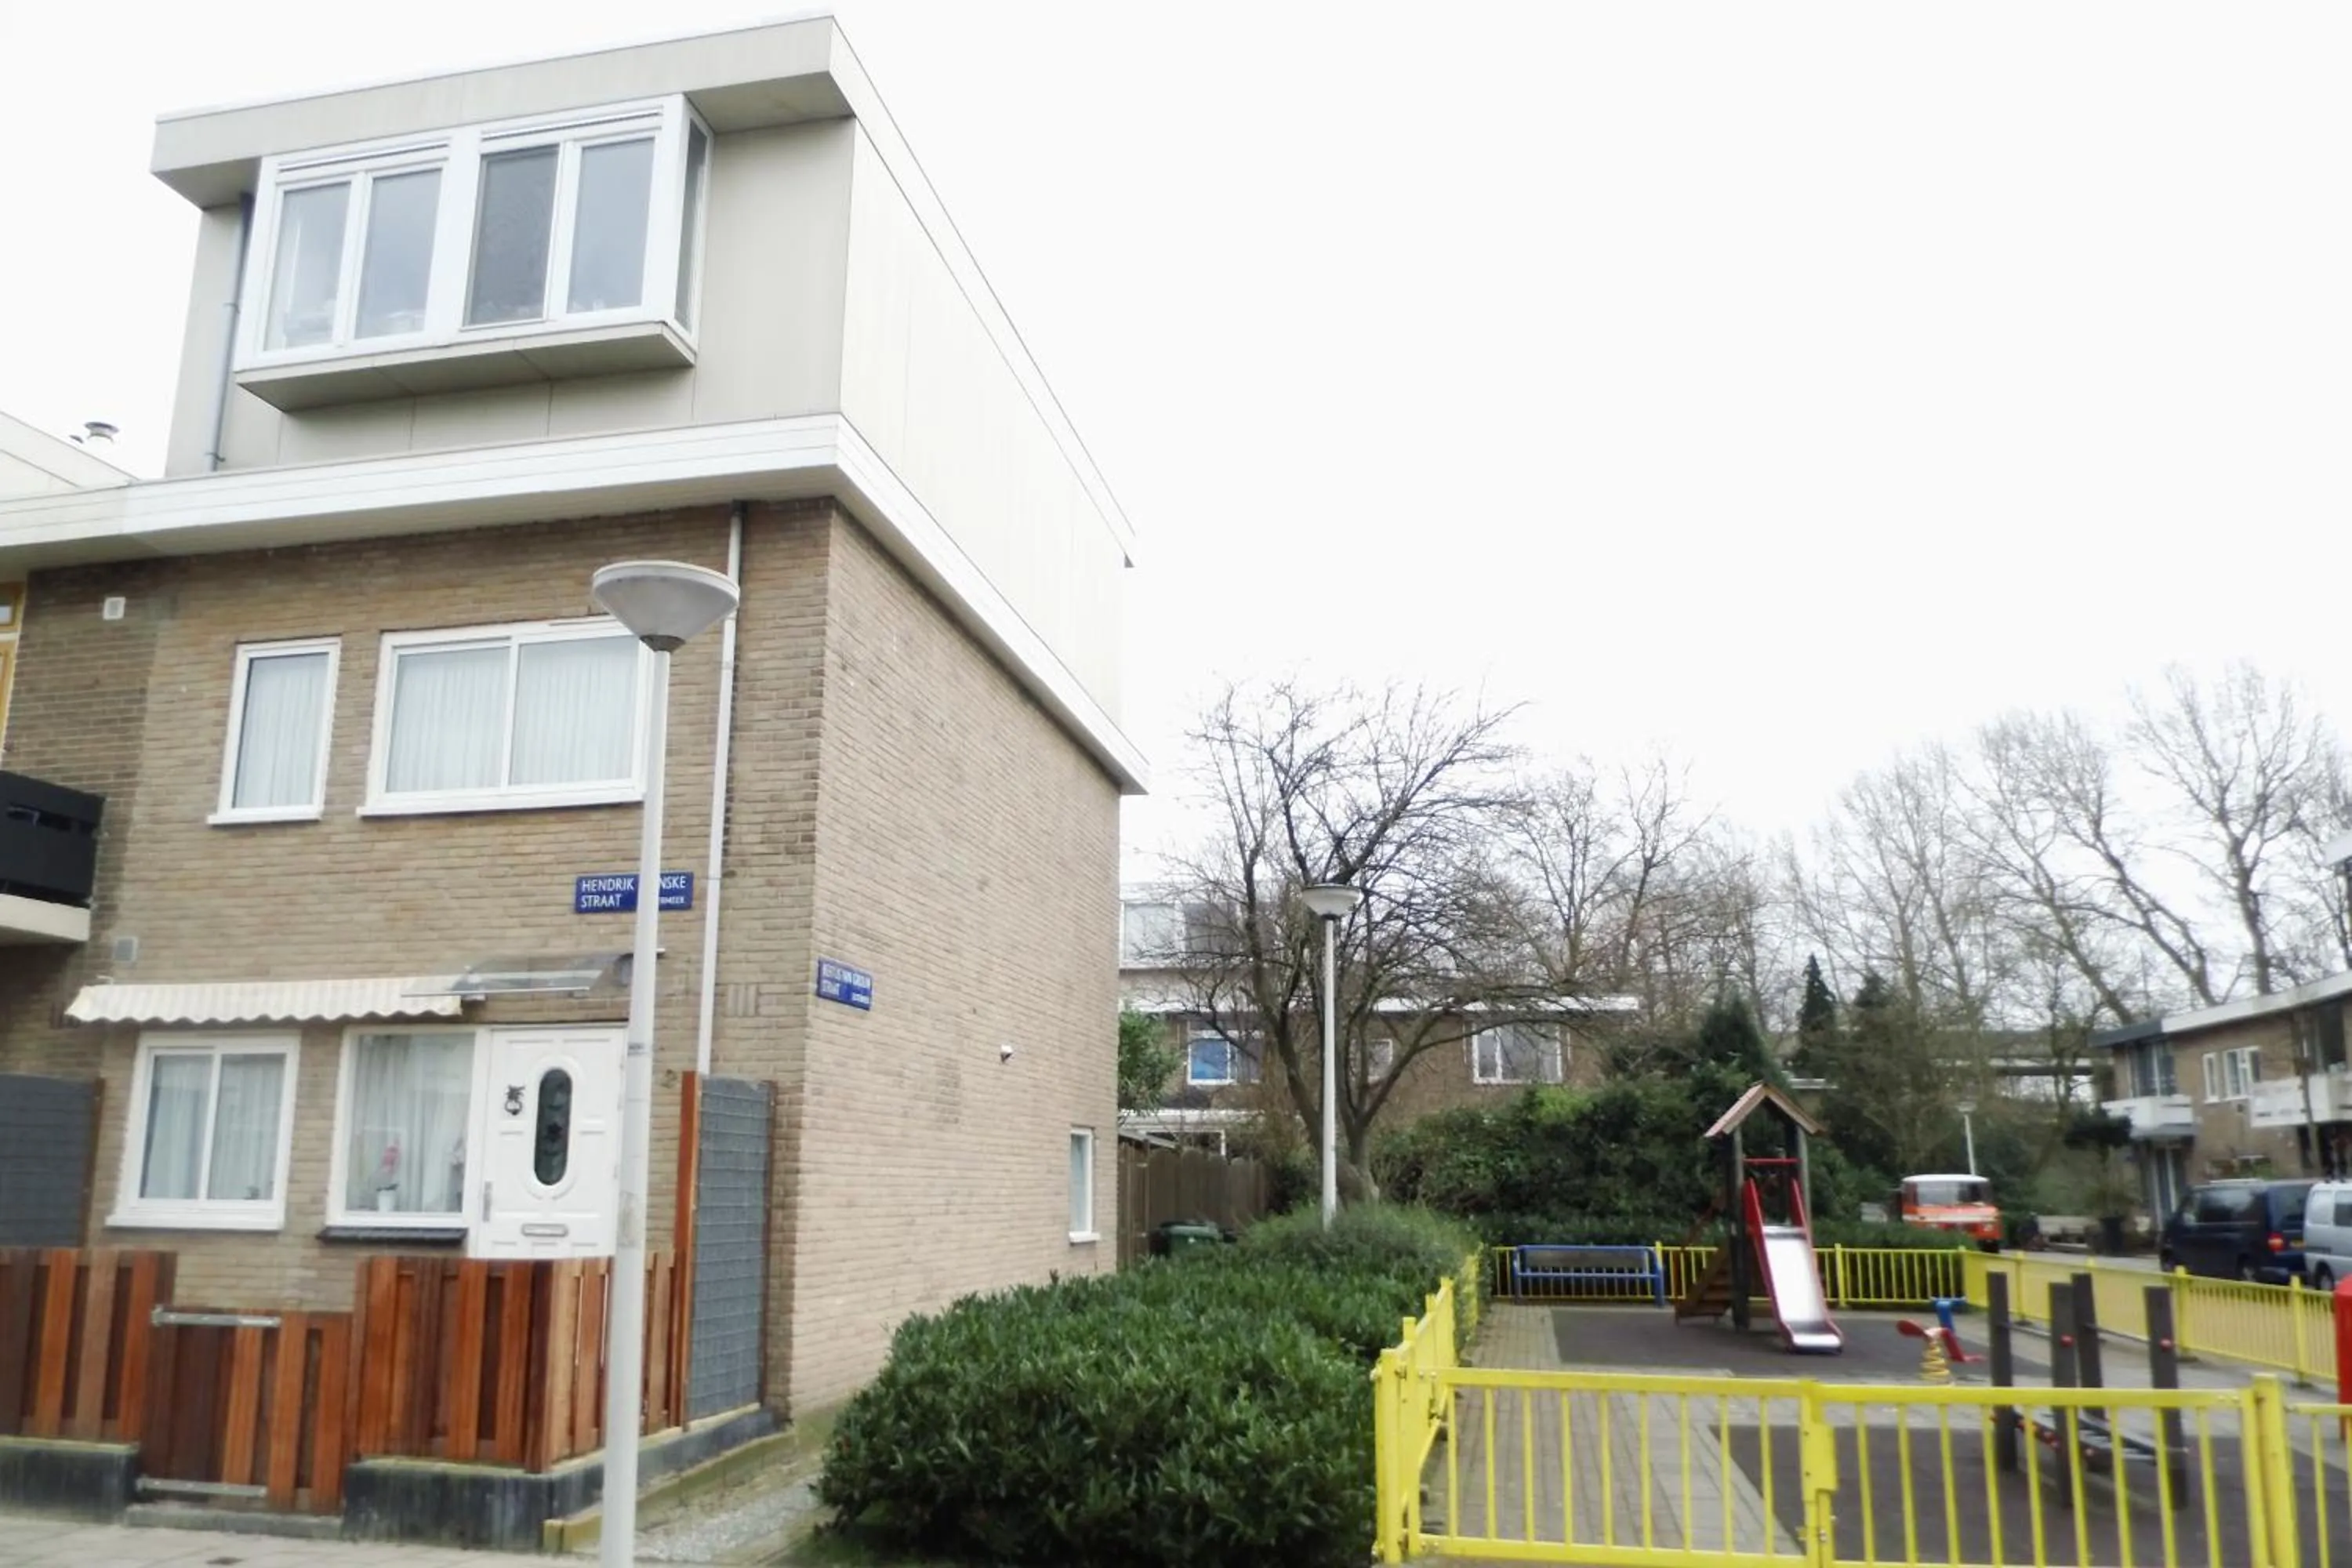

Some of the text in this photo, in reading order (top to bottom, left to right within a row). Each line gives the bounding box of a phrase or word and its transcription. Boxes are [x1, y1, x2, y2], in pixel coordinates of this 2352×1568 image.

[582, 876, 686, 892] HENDRIK NSKE
[581, 893, 622, 908] STRAAT
